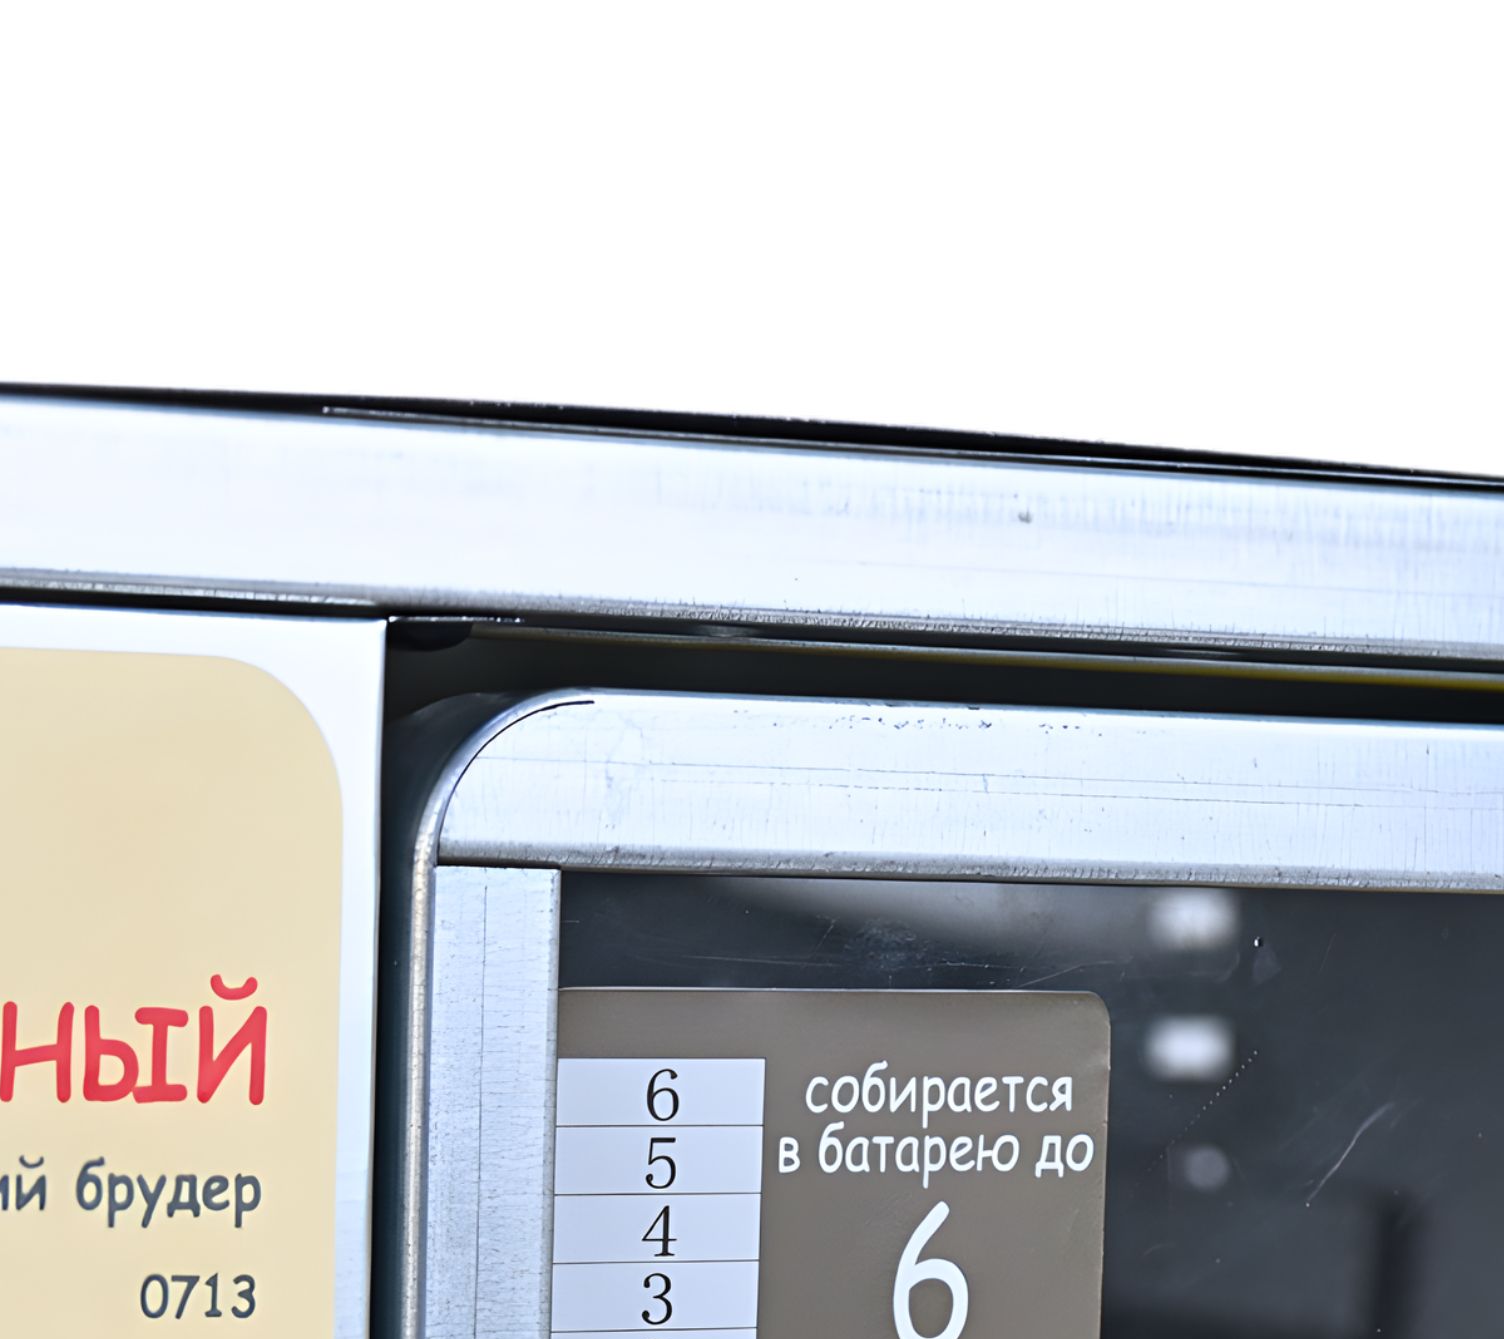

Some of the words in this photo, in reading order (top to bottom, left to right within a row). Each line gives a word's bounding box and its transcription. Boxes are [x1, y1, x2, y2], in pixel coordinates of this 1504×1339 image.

[646, 1068, 681, 1121] 6
[805, 1060, 1074, 1127] собирается
[645, 1136, 677, 1190] 5
[778, 1135, 800, 1174] в
[817, 1123, 1021, 1188] батарею
[1035, 1133, 1094, 1178] до
[75, 1158, 262, 1227] брудер
[641, 1206, 677, 1258] 4
[139, 1274, 257, 1320] 0713
[641, 1273, 673, 1325] 3
